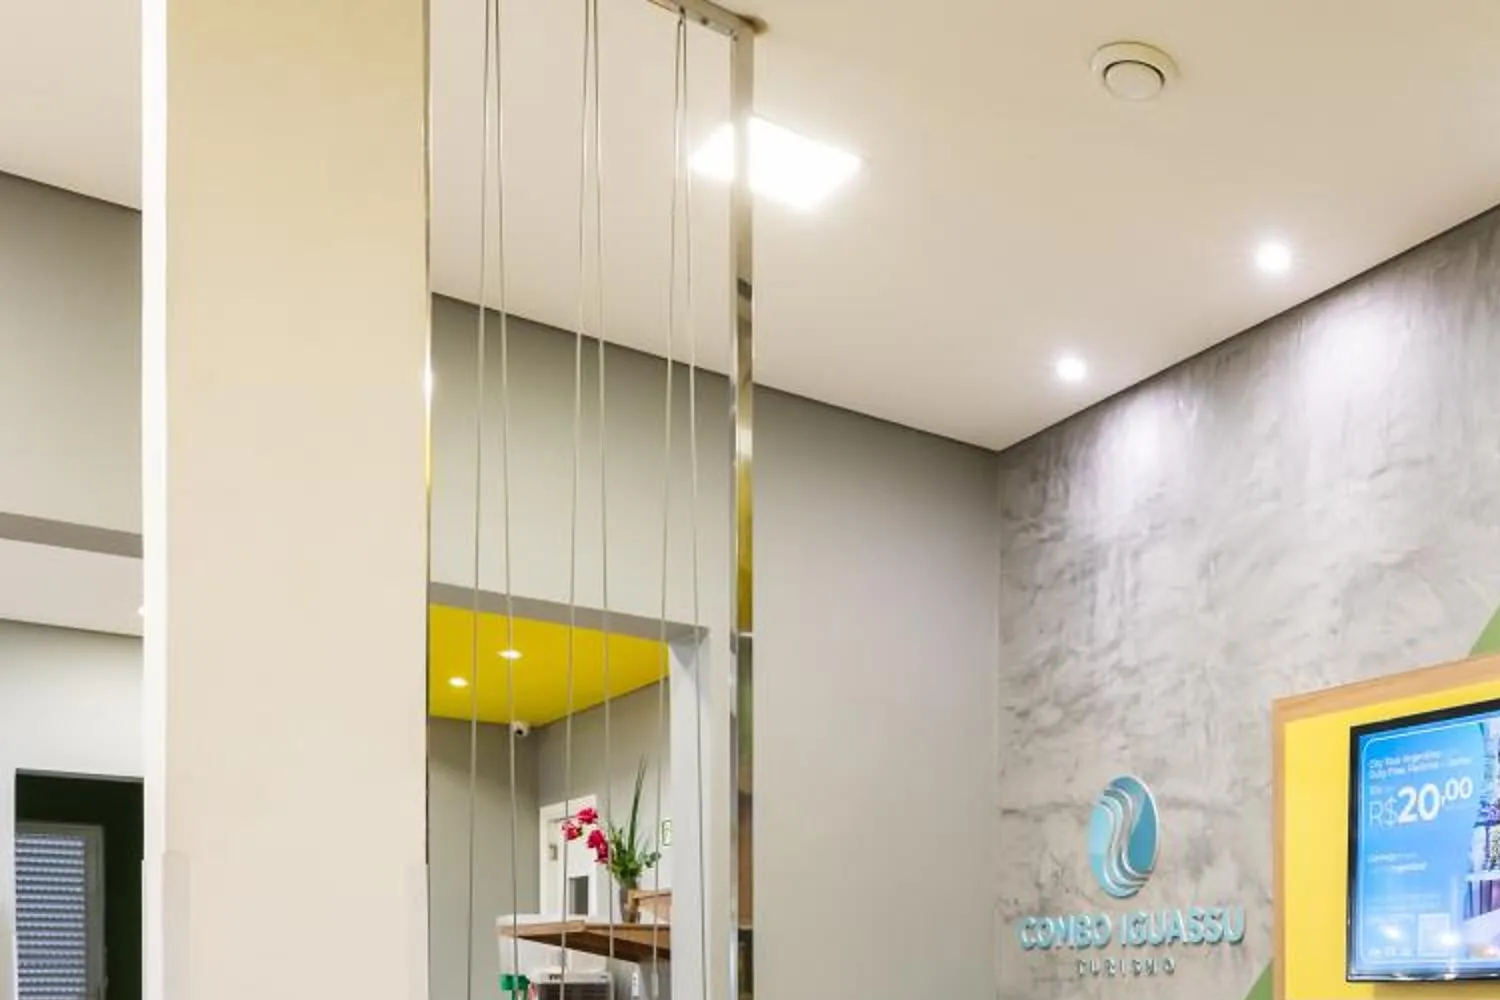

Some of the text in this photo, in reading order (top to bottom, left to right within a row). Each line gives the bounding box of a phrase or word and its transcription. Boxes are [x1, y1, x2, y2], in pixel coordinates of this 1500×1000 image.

[1017, 906, 1246, 950] COMBO IGUASSU
[1075, 957, 1176, 979] TURISMO
